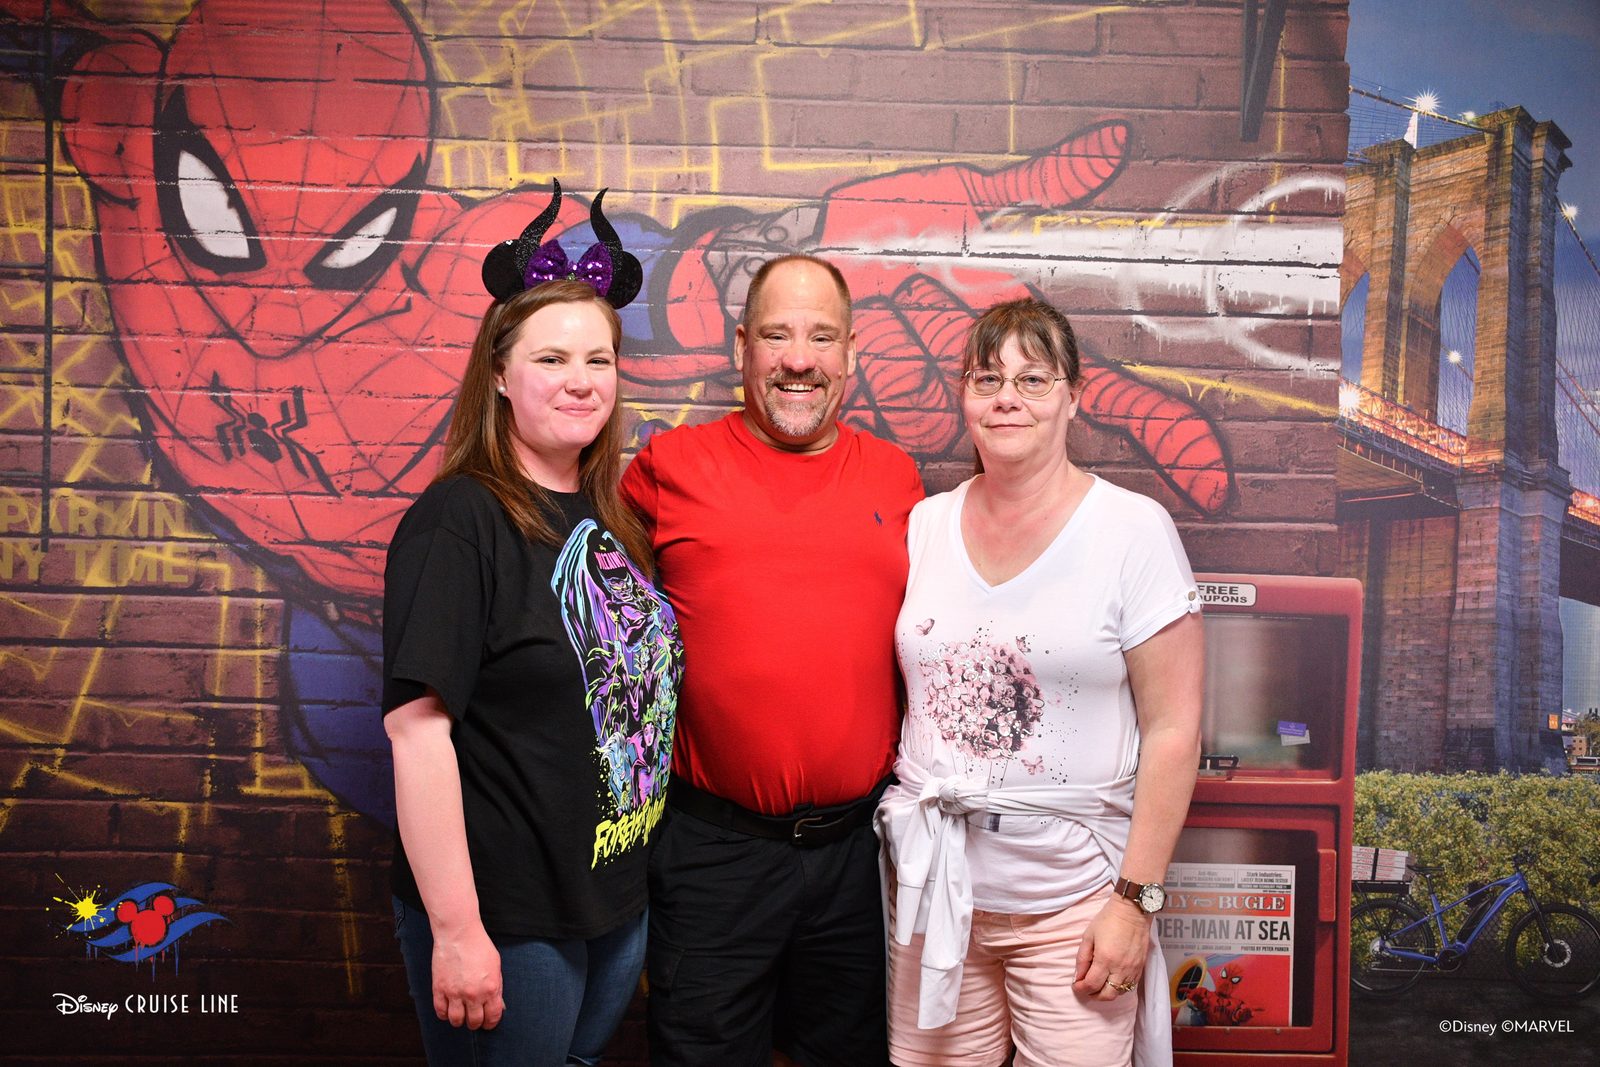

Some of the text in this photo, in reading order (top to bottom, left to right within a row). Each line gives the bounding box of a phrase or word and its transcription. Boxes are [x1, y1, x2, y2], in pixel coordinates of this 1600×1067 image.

[1197, 585, 1239, 595] FREE
[1200, 595, 1248, 603] UPONS
[1218, 895, 1285, 911] BUGLE
[1235, 920, 1255, 940] AT
[1258, 920, 1291, 941] SEA
